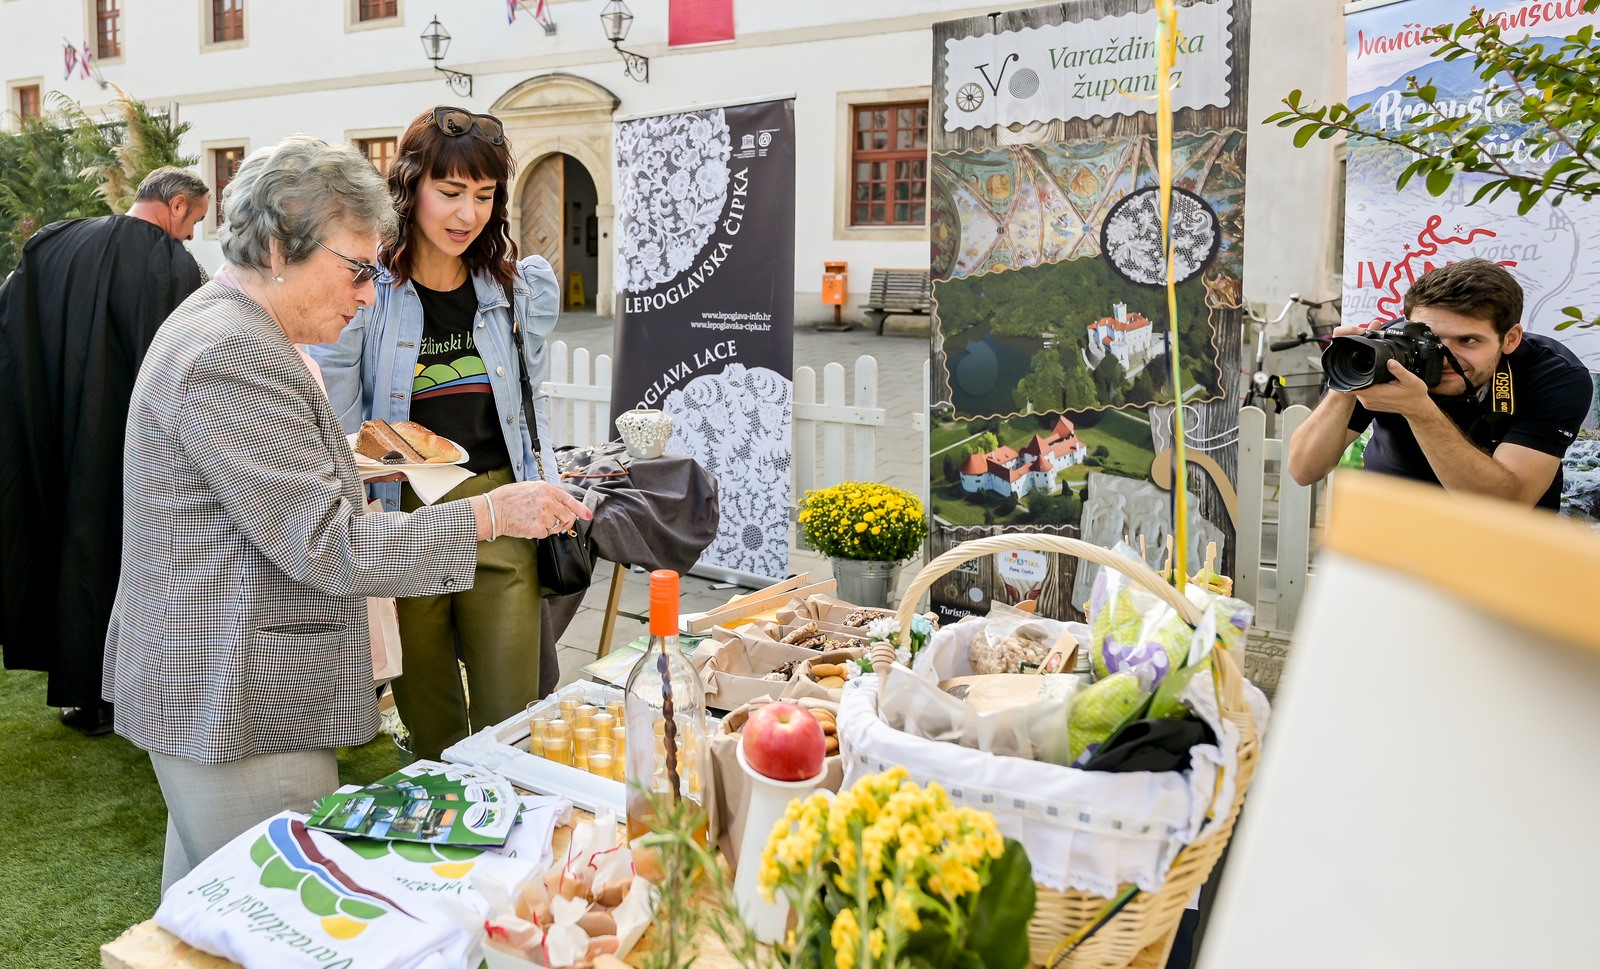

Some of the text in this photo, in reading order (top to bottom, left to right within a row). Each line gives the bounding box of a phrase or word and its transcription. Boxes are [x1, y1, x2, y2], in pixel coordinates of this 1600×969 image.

[1048, 34, 1205, 70] Varaždinka
[1071, 68, 1183, 102] župania
[625, 167, 749, 314] LEPOGLAVSKA ČIPKA
[690, 321, 771, 331] www.lepoglavska-cipka.hr
[701, 311, 771, 321] www.lepoglava-info.hr
[418, 333, 462, 355] ždinski
[635, 339, 738, 411] OGLAVA LACE
[1495, 372, 1510, 399] D850
